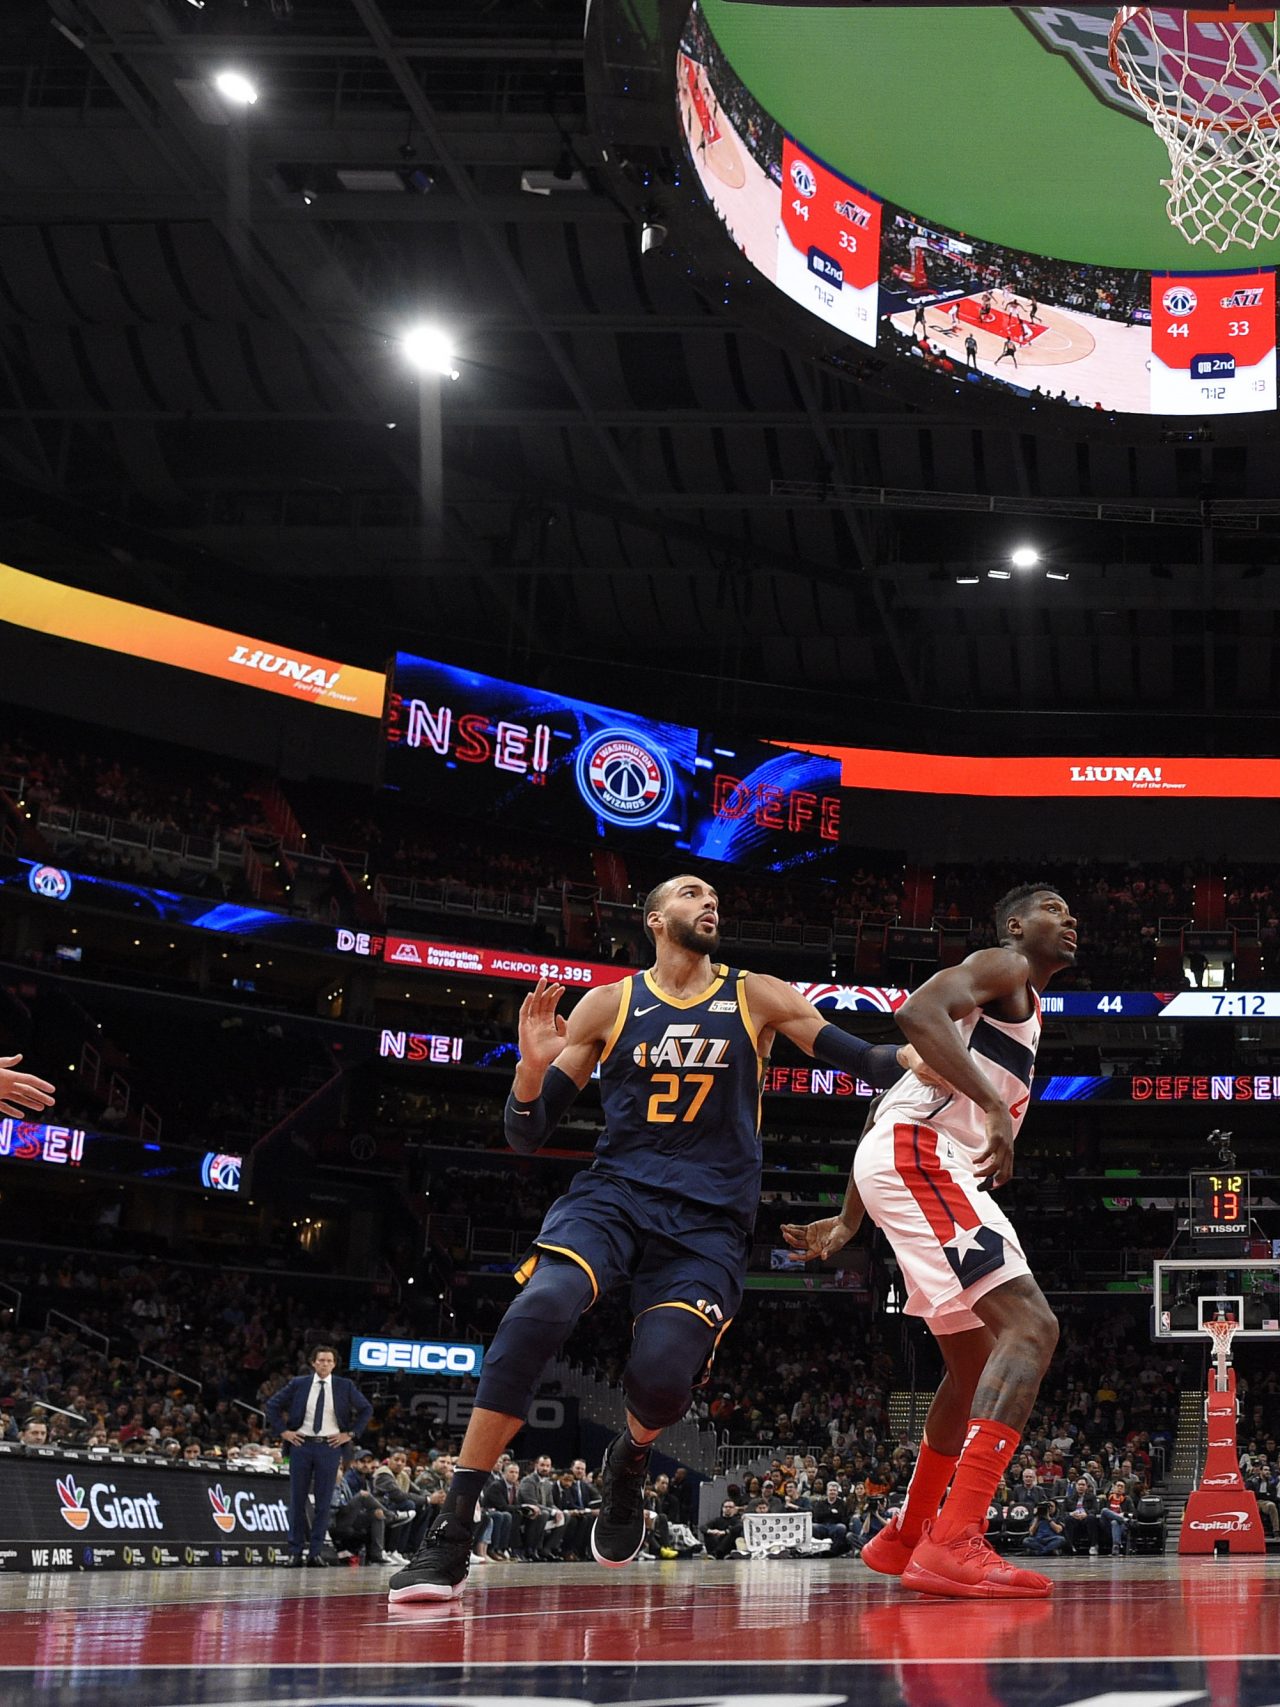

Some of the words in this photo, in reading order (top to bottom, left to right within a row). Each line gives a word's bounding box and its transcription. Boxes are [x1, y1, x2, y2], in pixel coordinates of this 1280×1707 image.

[792, 200, 809, 221] 44
[839, 231, 856, 252] 33
[825, 264, 843, 281] 2nd
[814, 285, 834, 307] 7:12
[1167, 323, 1189, 337] 44
[1228, 321, 1249, 336] 33
[1213, 359, 1234, 370] 2nd
[1201, 388, 1226, 399] 7:12
[599, 743, 654, 768] WASHINGTON
[603, 791, 645, 809] WIZARDS
[337, 929, 384, 956] DEF
[491, 960, 539, 974] JACKPOT:
[539, 963, 592, 982] $2,395
[1097, 996, 1123, 1013] 44
[1212, 995, 1266, 1016] 7:12
[633, 1024, 730, 1068] JAZZ
[647, 1074, 714, 1122] 27
[1209, 1177, 1241, 1192] 7:12
[1214, 1193, 1238, 1219] 13
[1209, 1225, 1247, 1233] TISSOT
[358, 1341, 476, 1371] GEICO
[90, 1483, 163, 1529] Giant
[234, 1491, 290, 1532] Giant
[31, 1549, 49, 1566] WE
[51, 1548, 73, 1565] ARE
